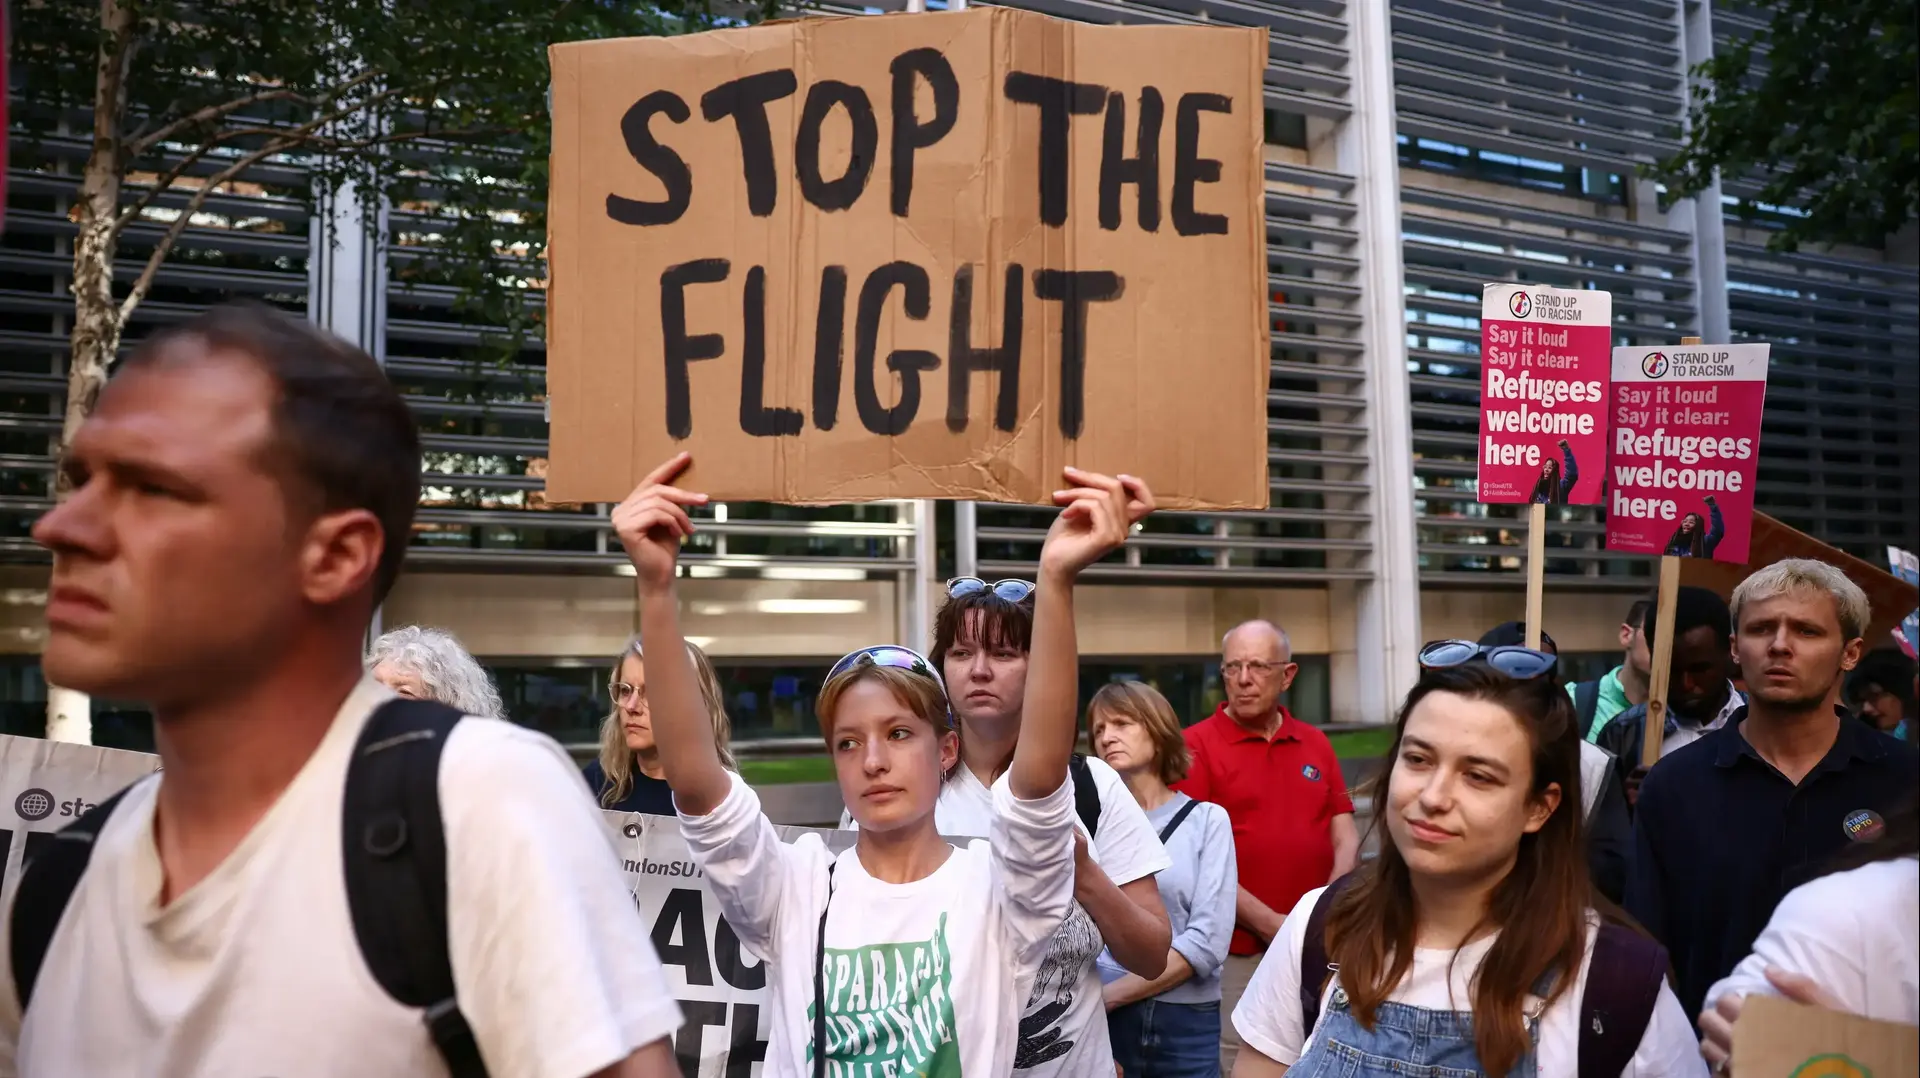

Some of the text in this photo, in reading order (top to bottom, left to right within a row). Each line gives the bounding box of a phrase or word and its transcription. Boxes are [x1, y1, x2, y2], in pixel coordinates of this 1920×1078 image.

[606, 47, 1233, 236] STOP THE
[1535, 294, 1577, 308] STAND UP
[1535, 307, 1582, 320] TO RACISM
[1489, 324, 1568, 348] Say it loud
[660, 258, 1126, 440] FLIGHT
[1488, 346, 1579, 369] Say it clear:
[1672, 352, 1729, 365] STAND UP
[1672, 365, 1734, 377] TO RACISM
[1487, 368, 1602, 408] Refugees
[1618, 385, 1718, 408] Say it loud
[1486, 403, 1595, 435] welcome
[1617, 406, 1729, 428] Say it clear:
[1485, 435, 1540, 466] here
[1616, 427, 1752, 465] Refugees
[1614, 459, 1743, 492] welcome
[1613, 489, 1677, 520] here
[1846, 812, 1870, 828] STAND
[1850, 824, 1861, 833] UP
[1861, 818, 1873, 827] TO
